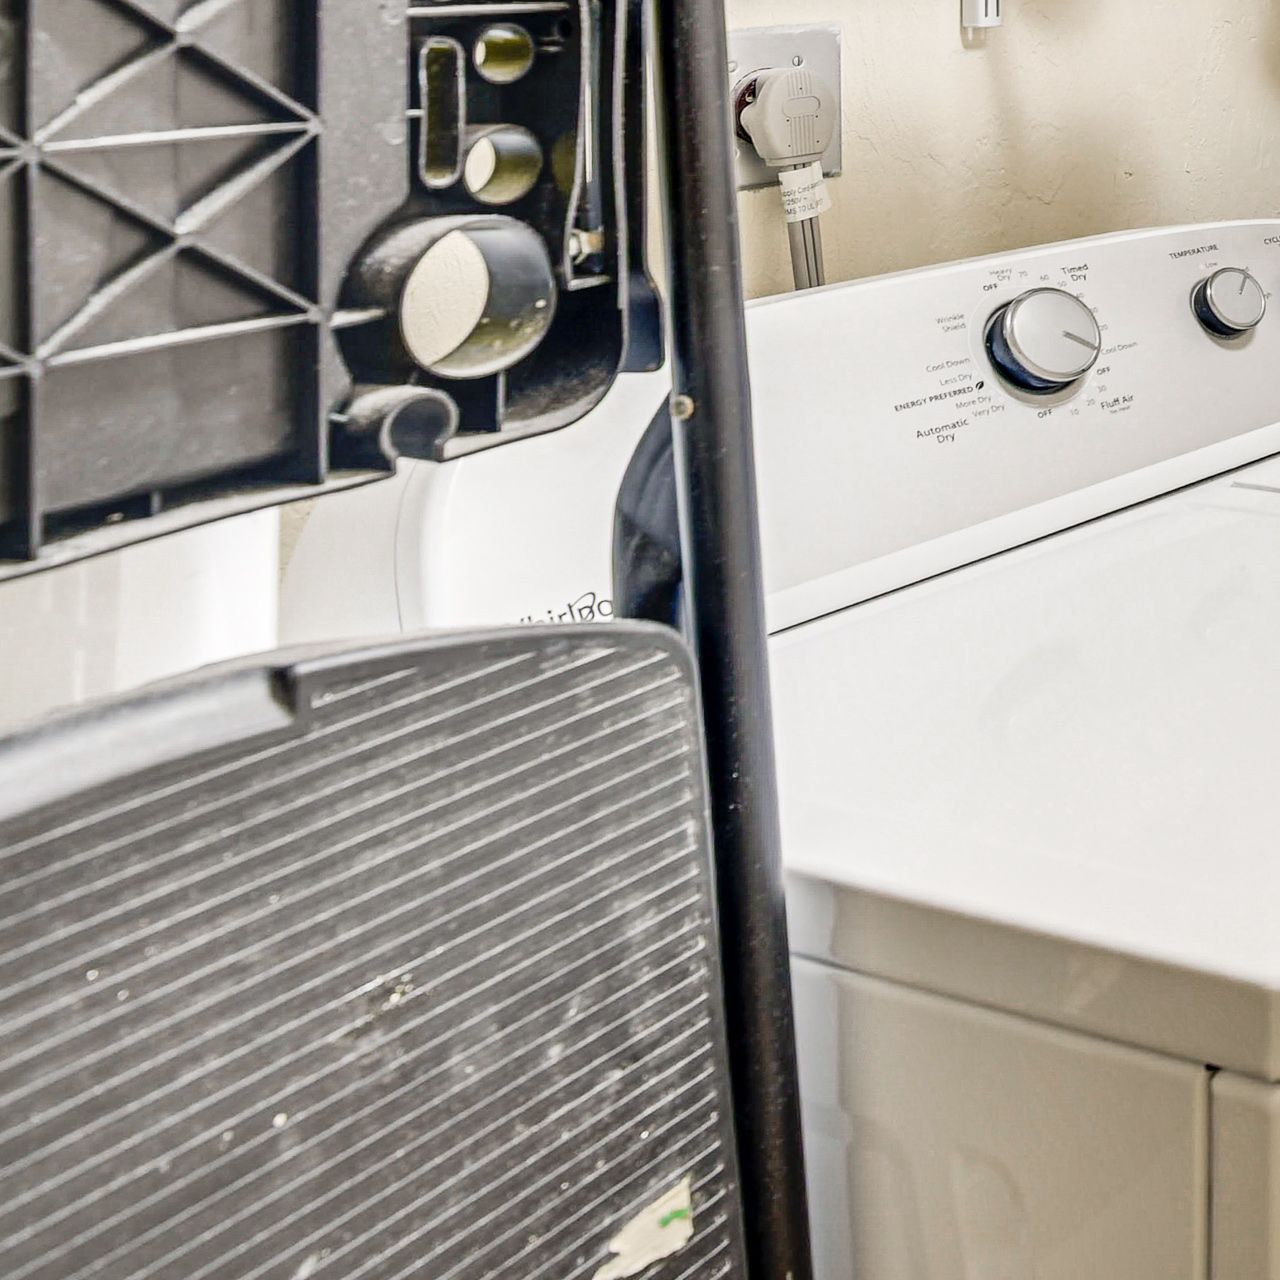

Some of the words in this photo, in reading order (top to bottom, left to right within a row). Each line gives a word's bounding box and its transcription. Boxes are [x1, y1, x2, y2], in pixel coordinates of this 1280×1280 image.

[1168, 244, 1219, 260] TEMPERATURE
[1060, 264, 1089, 274] Timed
[1071, 274, 1087, 282] Dry
[983, 283, 998, 291] OFF
[926, 361, 945, 373] Cool
[945, 357, 971, 368] Down
[1097, 366, 1111, 375] OFF
[939, 376, 957, 386] Less
[958, 373, 973, 383] Dry
[894, 397, 927, 412] ENERGY
[928, 386, 974, 403] PREFERRED
[955, 398, 976, 410] More
[977, 395, 992, 406] Dry
[1101, 398, 1120, 410] Fluff
[1122, 394, 1134, 404] Air
[972, 407, 990, 418] Very
[991, 403, 1005, 414] Dry
[1037, 409, 1053, 419] OFF
[916, 418, 970, 438] Automatic
[937, 433, 956, 444] Dry
